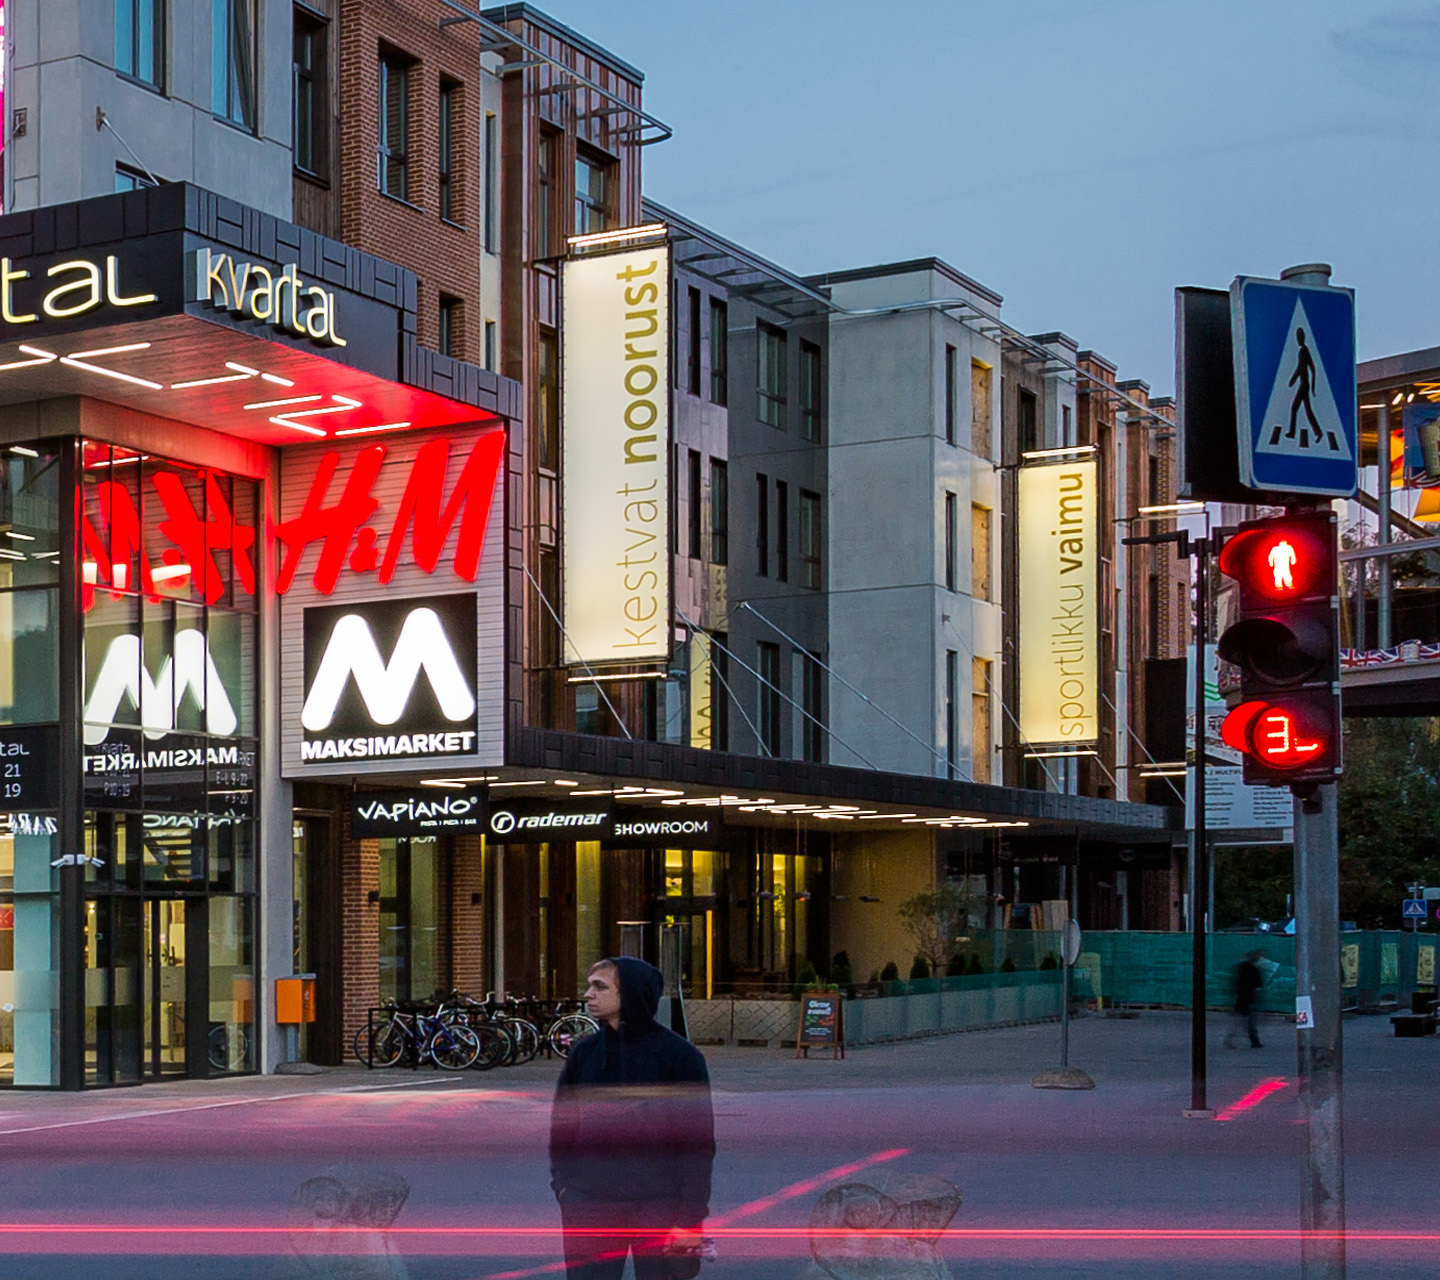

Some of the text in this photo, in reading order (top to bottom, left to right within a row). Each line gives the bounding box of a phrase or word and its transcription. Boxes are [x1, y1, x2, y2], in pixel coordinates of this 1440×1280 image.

[612, 260, 658, 650] kestvat noorust
[274, 431, 506, 595] H&M
[1051, 472, 1091, 737] sportlikku vaimu
[300, 731, 476, 761] MAKSIMARKET
[517, 812, 606, 829] rademar
[615, 821, 707, 835] SHOWROOM
